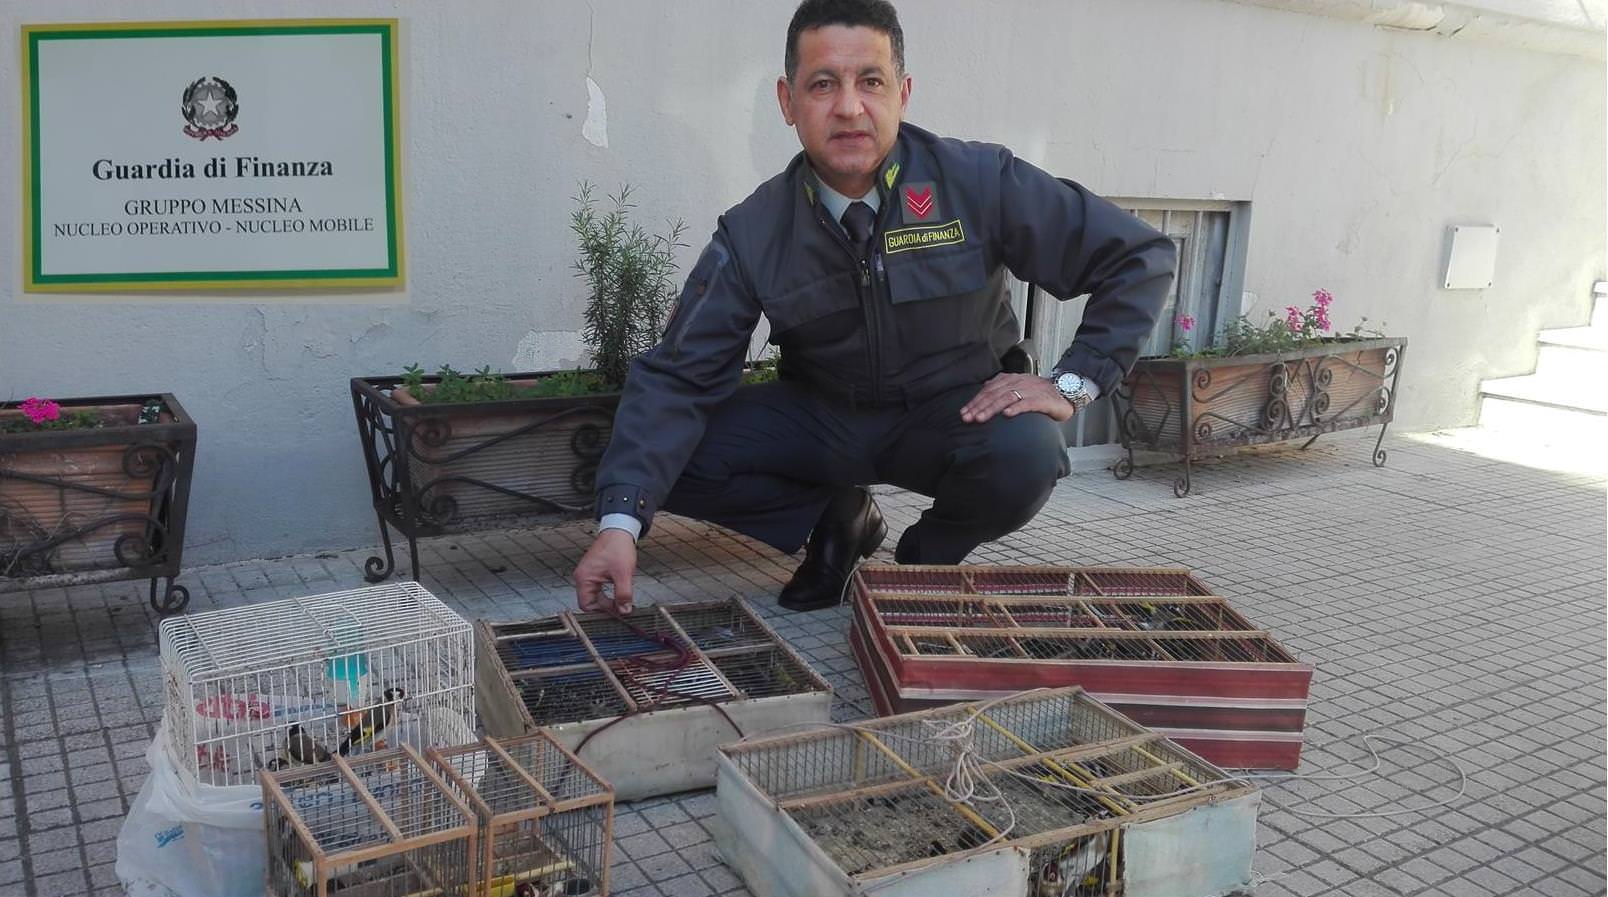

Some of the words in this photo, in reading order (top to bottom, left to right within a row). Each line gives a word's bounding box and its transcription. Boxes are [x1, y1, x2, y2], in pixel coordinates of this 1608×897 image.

[93, 158, 195, 181] Guardia
[203, 156, 227, 179] di
[235, 156, 333, 178] Finanza
[124, 199, 206, 216] GRUPPO
[211, 197, 303, 215] MESSINA
[54, 221, 123, 238] NUCLEO
[127, 220, 222, 236] OPERATIVO
[236, 219, 305, 235] NUCLEO
[309, 217, 374, 233] MOBILE
[888, 233, 921, 247] GUARDIA
[928, 227, 960, 242] FINANZA
